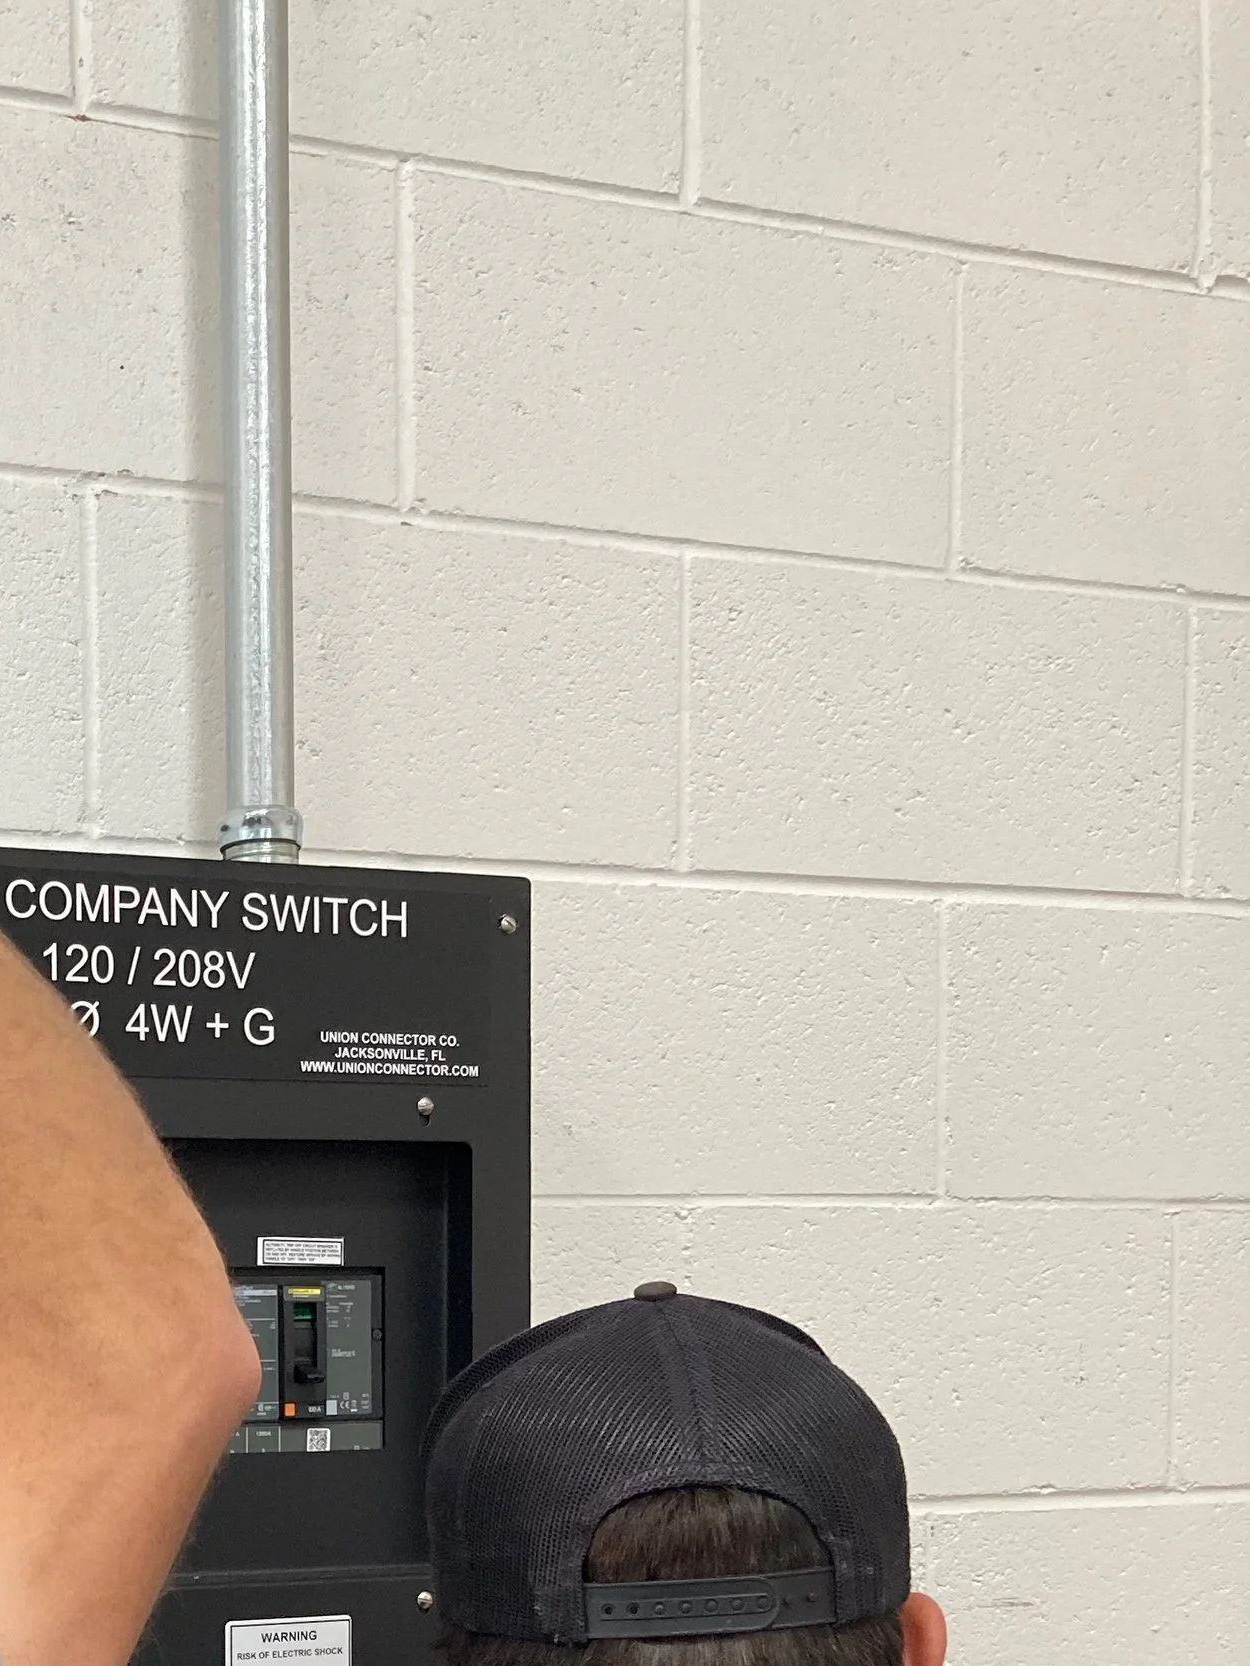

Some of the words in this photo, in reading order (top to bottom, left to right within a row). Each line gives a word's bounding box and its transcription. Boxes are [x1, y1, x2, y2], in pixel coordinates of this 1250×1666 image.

[5, 878, 230, 929] COMPANY
[242, 892, 408, 938] SWITCH
[42, 942, 115, 984] 120
[126, 946, 141, 985] /
[153, 948, 256, 989] 208V
[124, 1003, 193, 1043] 4W
[205, 1012, 230, 1038] +
[243, 1007, 276, 1046] G
[320, 1031, 359, 1044] UNION
[361, 1032, 437, 1046] CONNECTOR
[439, 1035, 461, 1047] CO.
[334, 1047, 429, 1062] JACKSONVILLE,
[431, 1049, 447, 1062] FL
[300, 1060, 480, 1077] WWW.UNIONCONNECTOR.COM
[261, 1630, 318, 1643] WARNING
[237, 1652, 257, 1660] RISK
[258, 1651, 270, 1659] OF
[272, 1648, 312, 1659] ELECTRIC
[314, 1647, 343, 1656] SHOCK
